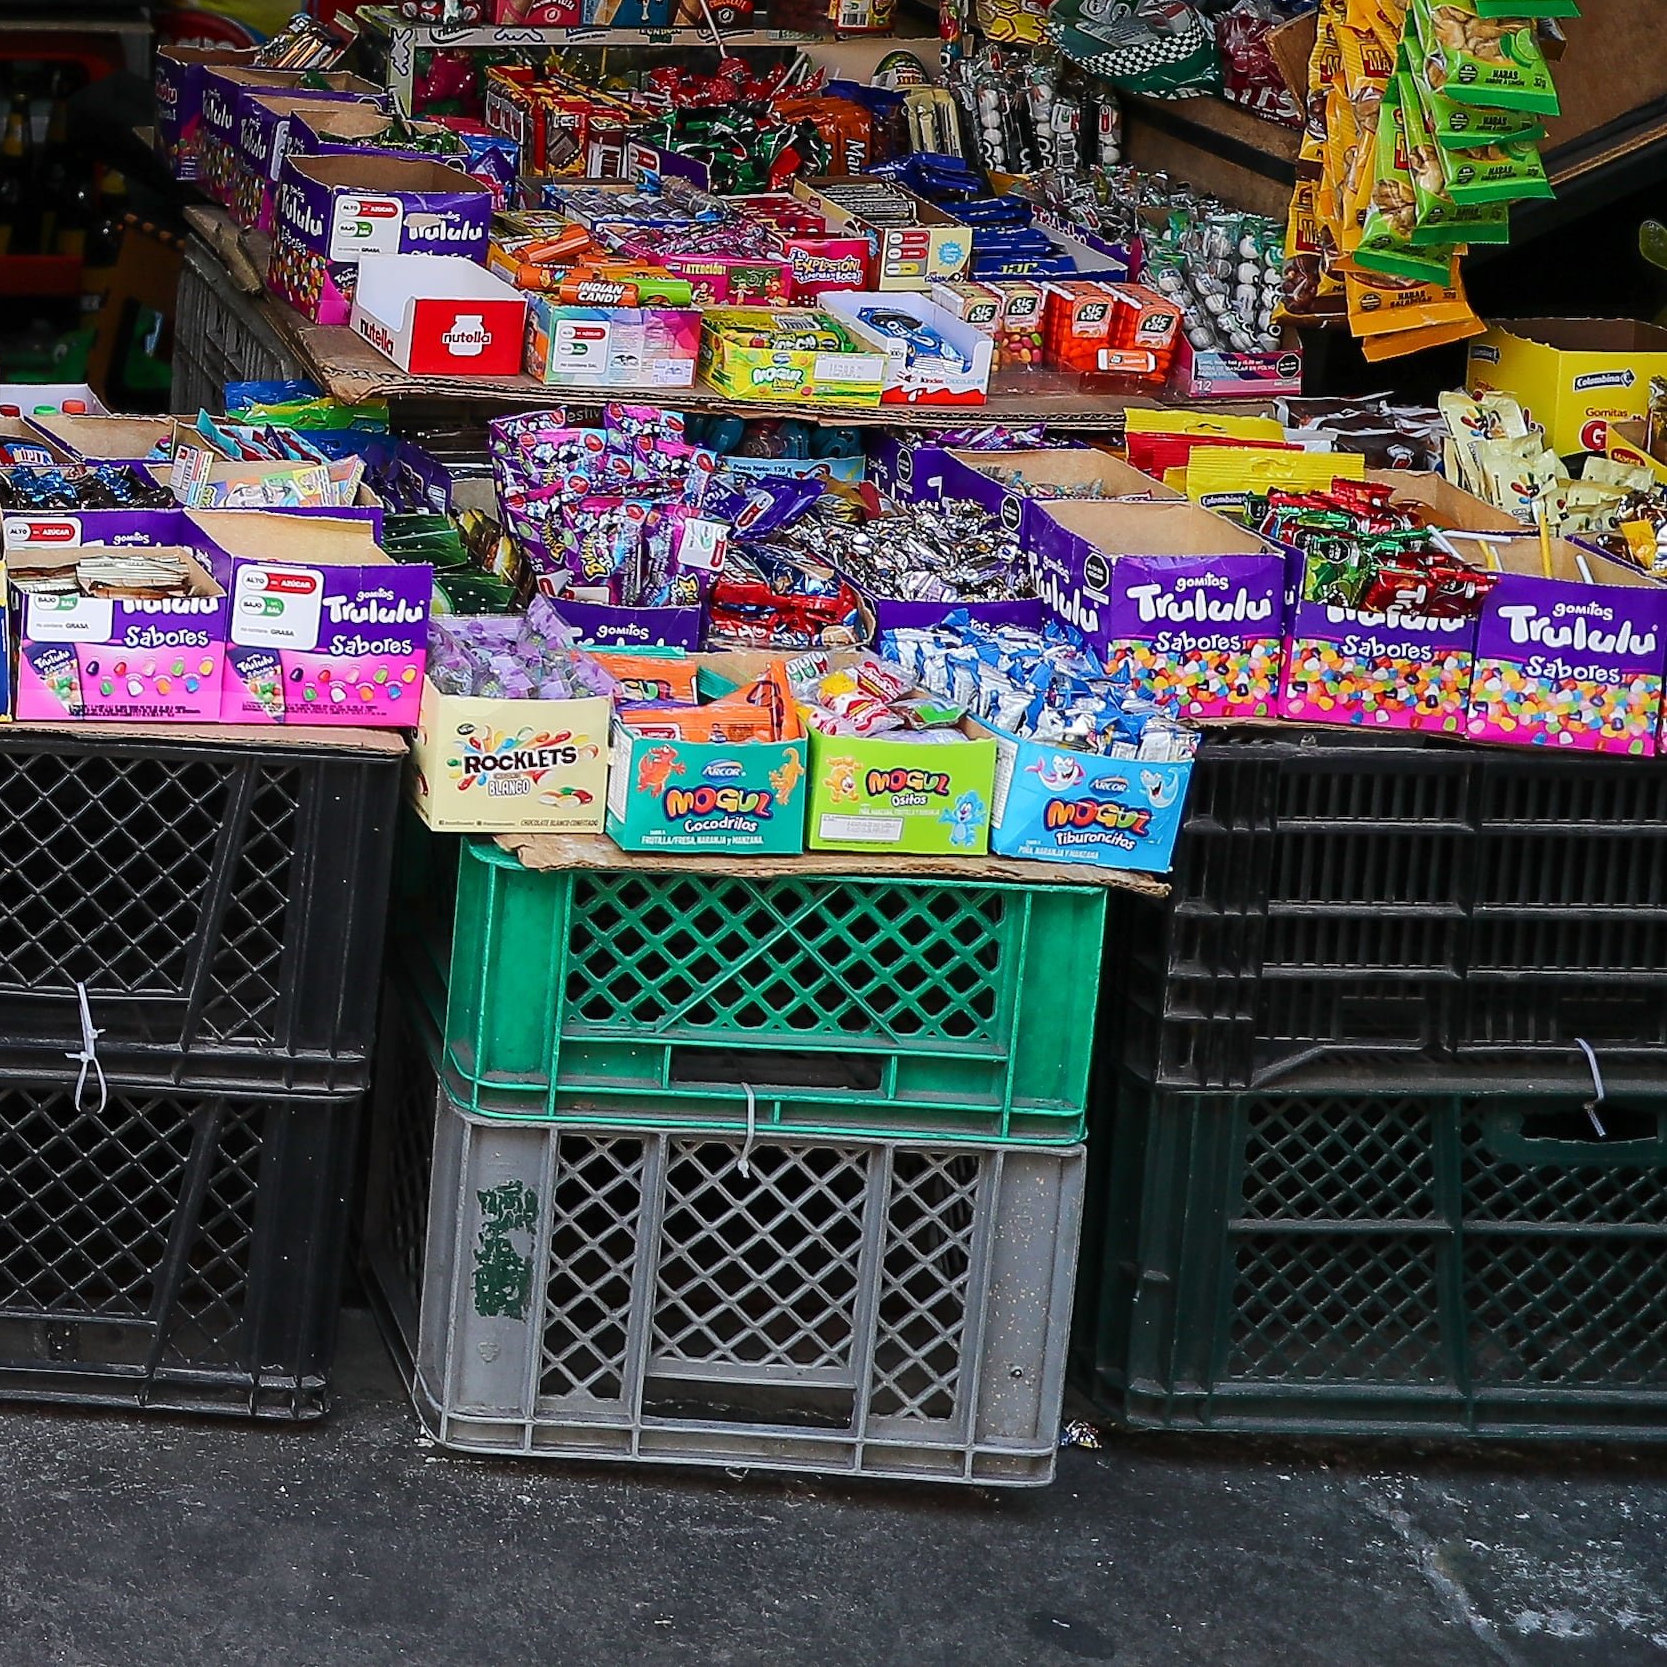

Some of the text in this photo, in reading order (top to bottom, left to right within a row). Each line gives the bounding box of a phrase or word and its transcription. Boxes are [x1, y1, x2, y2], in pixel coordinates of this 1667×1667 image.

[577, 291, 623, 305] CANDY
[578, 281, 626, 295] INDIAN
[359, 318, 395, 357] nutella
[443, 329, 491, 346] nutella
[1577, 375, 1620, 386] Colombina
[1586, 408, 1627, 418] Gomitas
[323, 596, 425, 624] Trululu
[1127, 586, 1272, 623] Trululu
[124, 626, 209, 646] Sabores
[1498, 604, 1658, 656] Trululu
[329, 634, 413, 656] Sabores
[1155, 632, 1241, 654] Sabores
[1342, 636, 1432, 661] Sabores
[1526, 656, 1620, 683] Sabores
[463, 745, 577, 774] ROCKLETS
[867, 770, 950, 795] MOGUL
[666, 787, 773, 817] MOGUL
[891, 794, 927, 807] Ositos
[684, 817, 757, 832] Cocodrilos
[1046, 801, 1152, 835] MOGUL
[1056, 832, 1135, 851] Tiburoncitos
